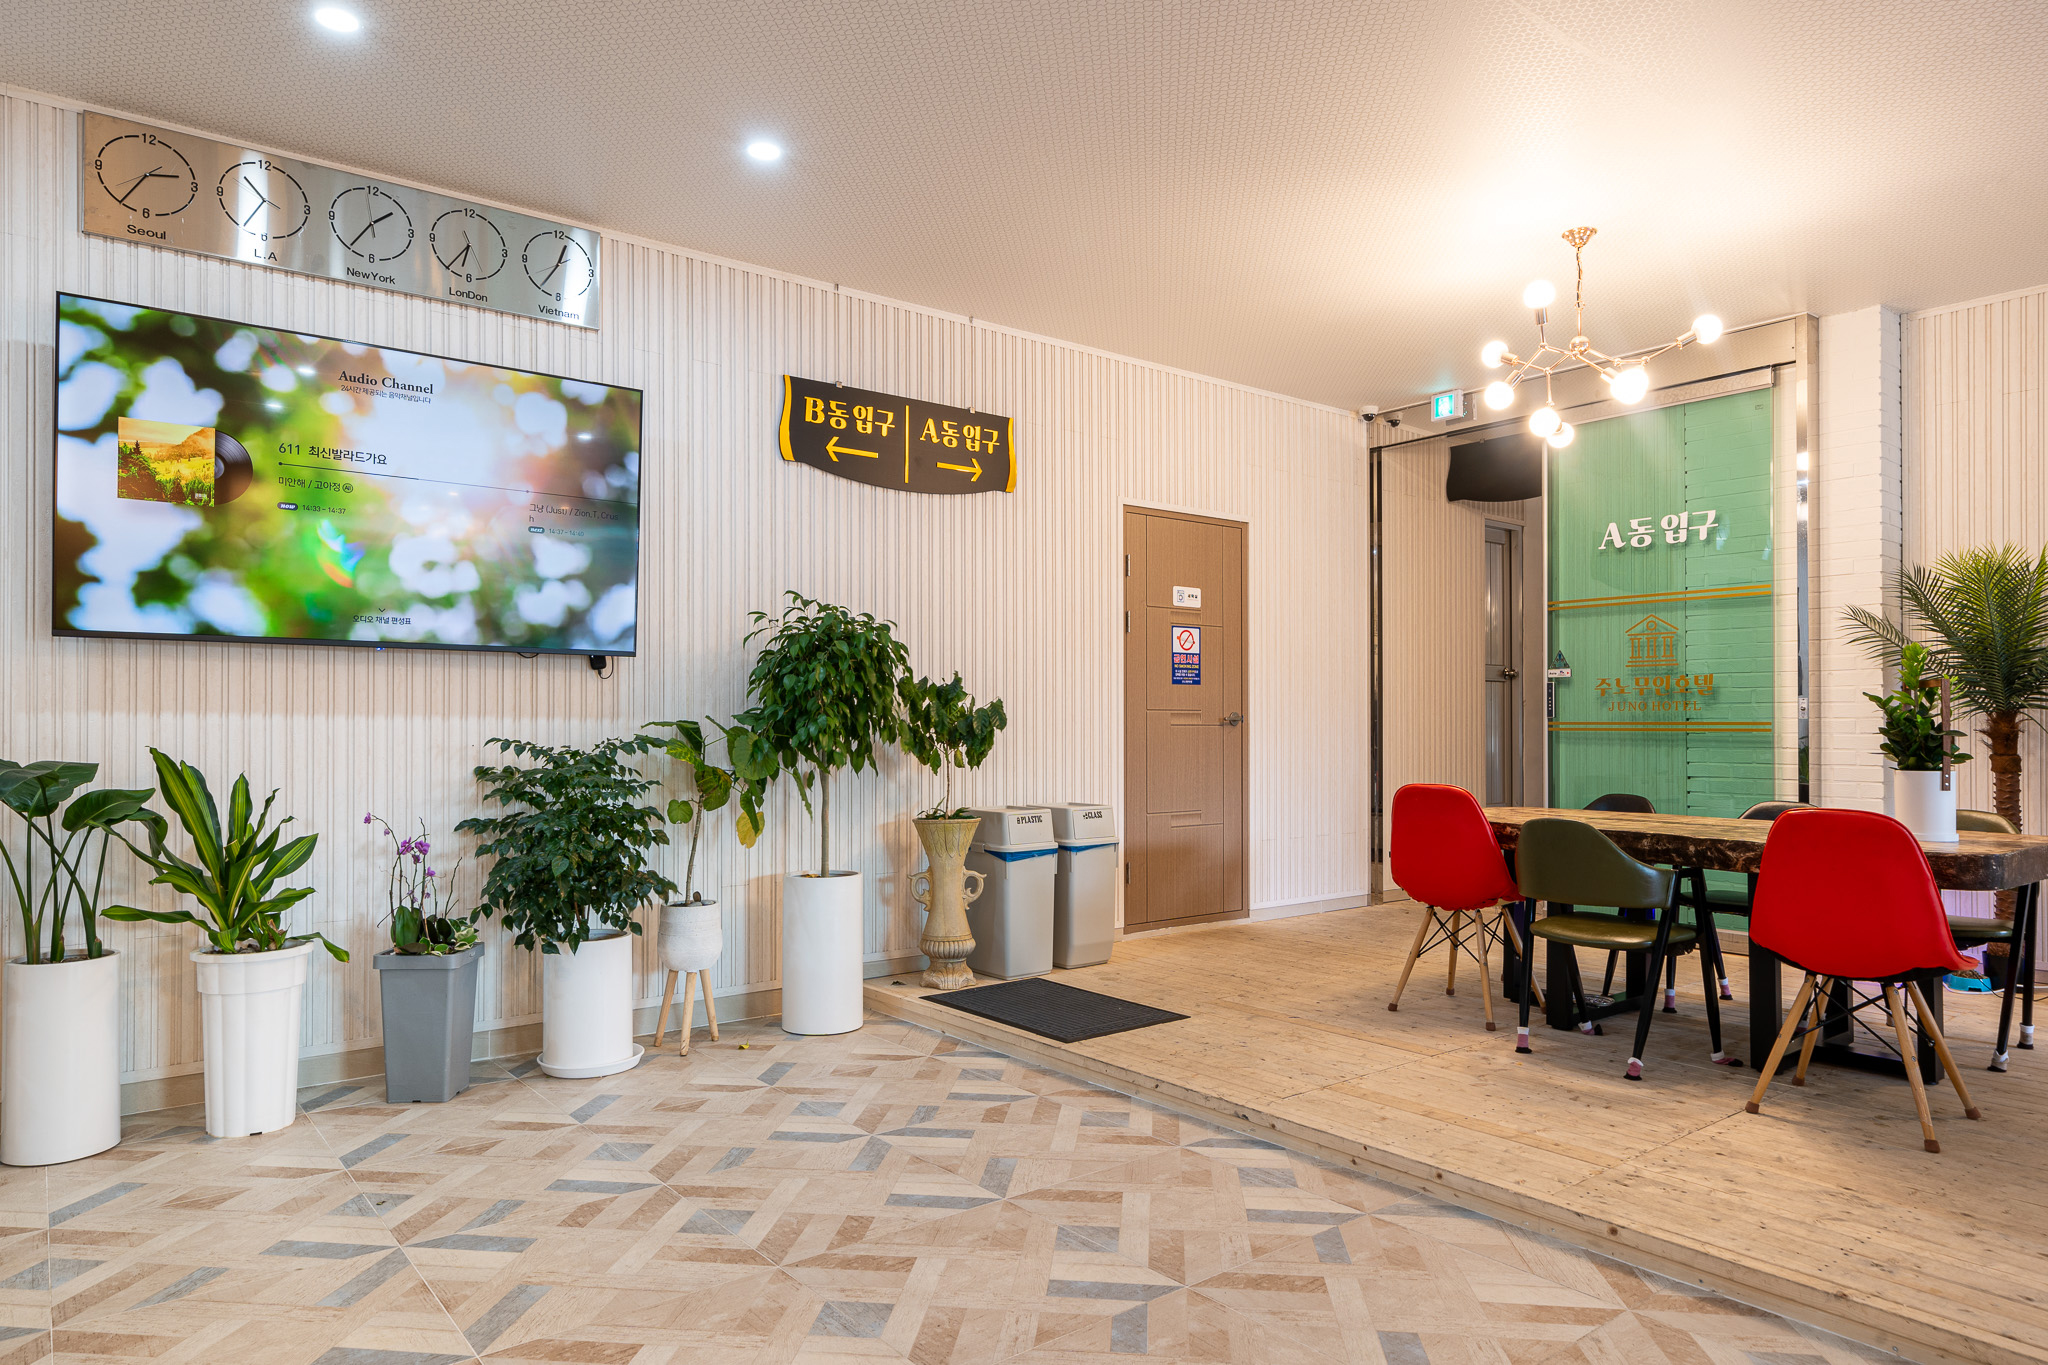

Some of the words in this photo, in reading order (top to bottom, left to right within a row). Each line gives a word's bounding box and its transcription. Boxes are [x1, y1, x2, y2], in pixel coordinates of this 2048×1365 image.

[141, 134, 156, 145] 12
[95, 159, 102, 170] 9
[258, 160, 272, 171] 12
[190, 182, 198, 193] 3
[216, 186, 224, 197] 9
[366, 185, 380, 197] 12
[142, 208, 150, 219] 6
[304, 204, 311, 215] 3
[328, 210, 335, 220] 9
[464, 208, 476, 219] 12
[126, 224, 166, 240] Seoul
[408, 228, 414, 239] 3
[429, 232, 436, 243] 9
[554, 230, 565, 240] 12
[254, 249, 278, 262] L.A
[368, 254, 375, 263] 6
[502, 248, 508, 258] 3
[522, 254, 528, 263] 9
[466, 273, 472, 283] 6
[588, 268, 594, 278] 3
[449, 286, 488, 302] LonDon
[538, 304, 580, 320] Vietnam
[338, 370, 378, 386] Audio
[381, 376, 434, 395] Channel
[340, 384, 362, 394] 24시간
[278, 442, 300, 456] 611
[308, 445, 388, 466] 최신발라드가요
[278, 476, 306, 488] 미안해
[314, 480, 341, 492] 고아정
[328, 507, 346, 515] 14:37
[529, 503, 544, 514] 그냥
[600, 511, 619, 520] Crus
[353, 615, 374, 623] 오디오
[375, 616, 390, 624] 채널
[391, 617, 411, 625] 편성표
[1608, 700, 1648, 712] JUNO
[1652, 700, 1702, 712] HOTEL
[1020, 815, 1043, 824] PLASTIC
[1088, 810, 1102, 820] GLASS
